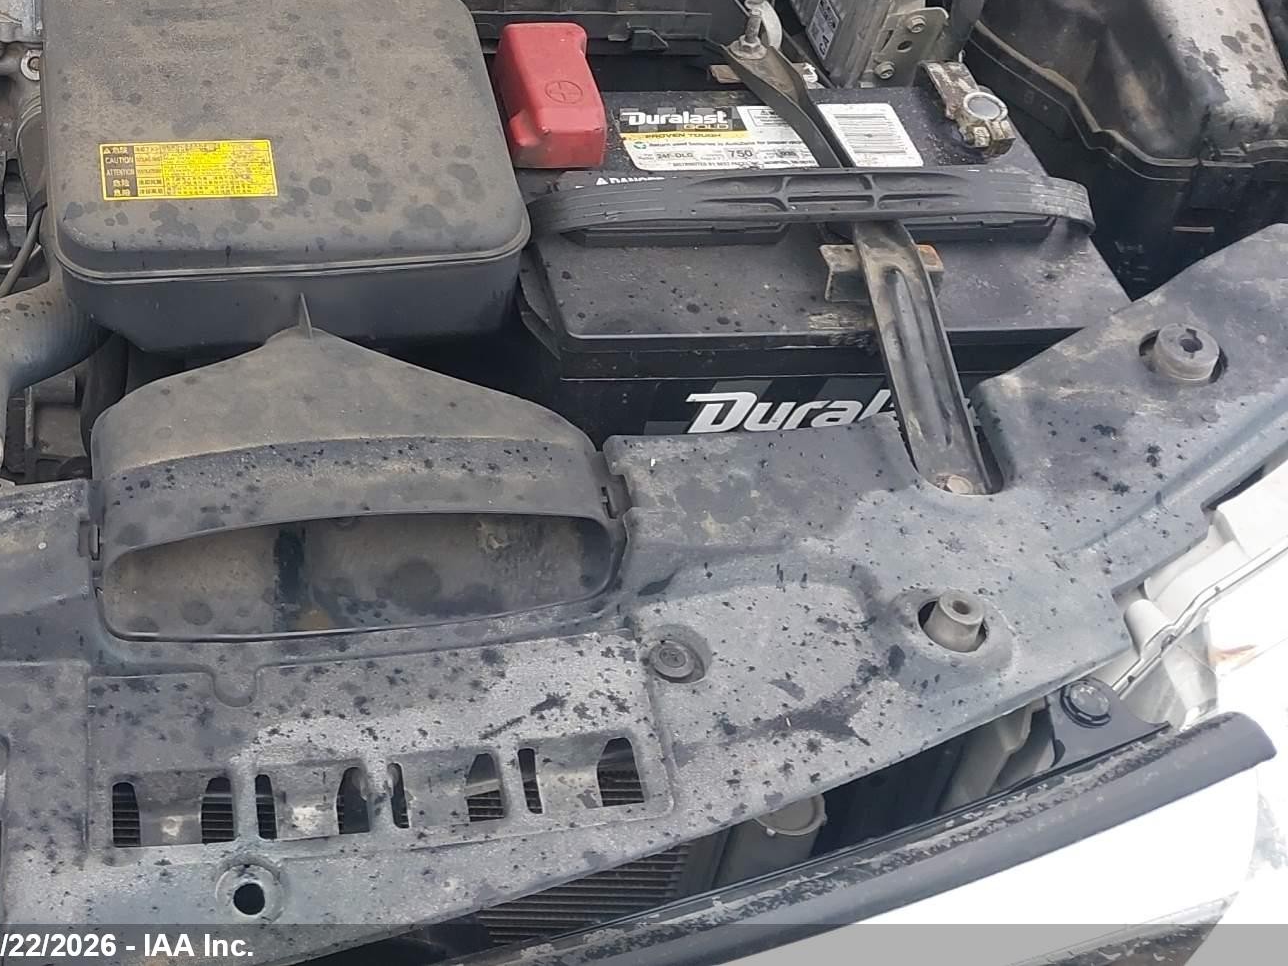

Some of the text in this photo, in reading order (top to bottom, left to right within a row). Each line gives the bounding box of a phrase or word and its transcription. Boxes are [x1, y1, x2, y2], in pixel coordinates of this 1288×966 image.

[621, 110, 729, 126] Duralast
[728, 149, 754, 158] 750
[105, 156, 134, 164] CAUTION
[686, 389, 898, 434] Dural
